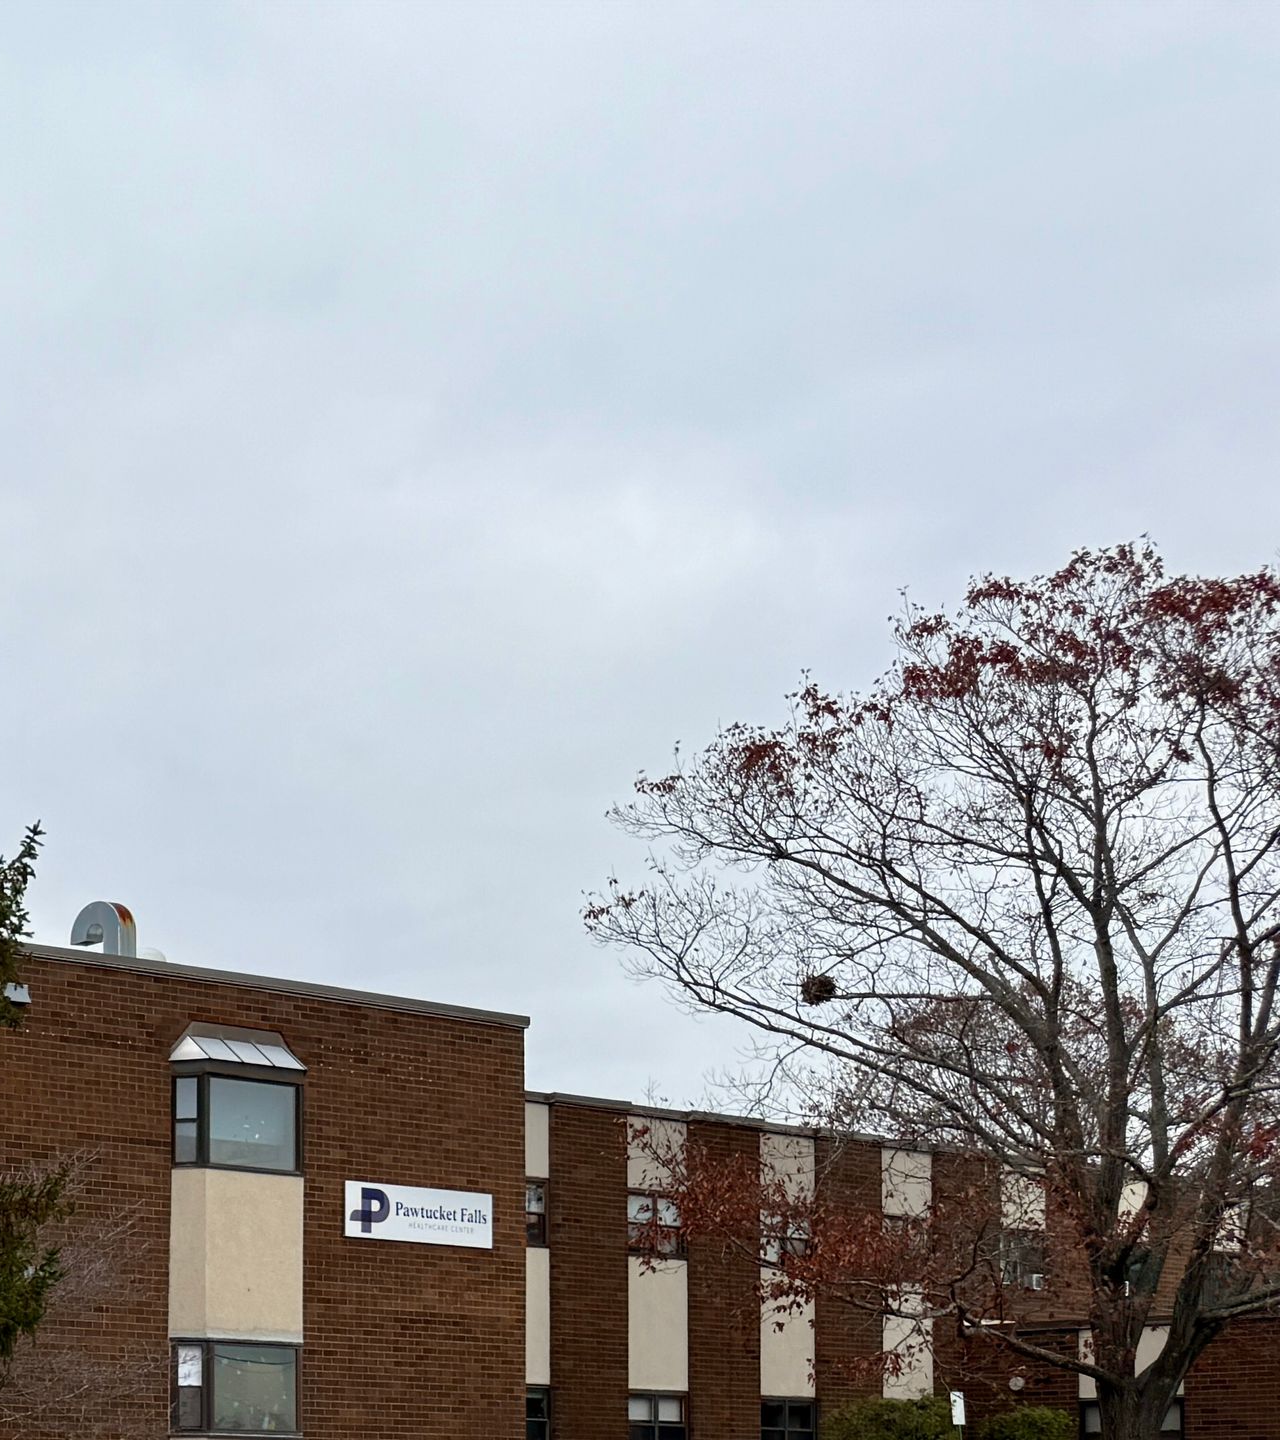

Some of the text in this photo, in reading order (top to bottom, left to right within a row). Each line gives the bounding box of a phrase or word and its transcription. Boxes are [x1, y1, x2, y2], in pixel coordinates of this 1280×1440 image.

[395, 1201, 487, 1225] Pawtucket Falls
[408, 1222, 474, 1234] HEALTHCARE CENTER
